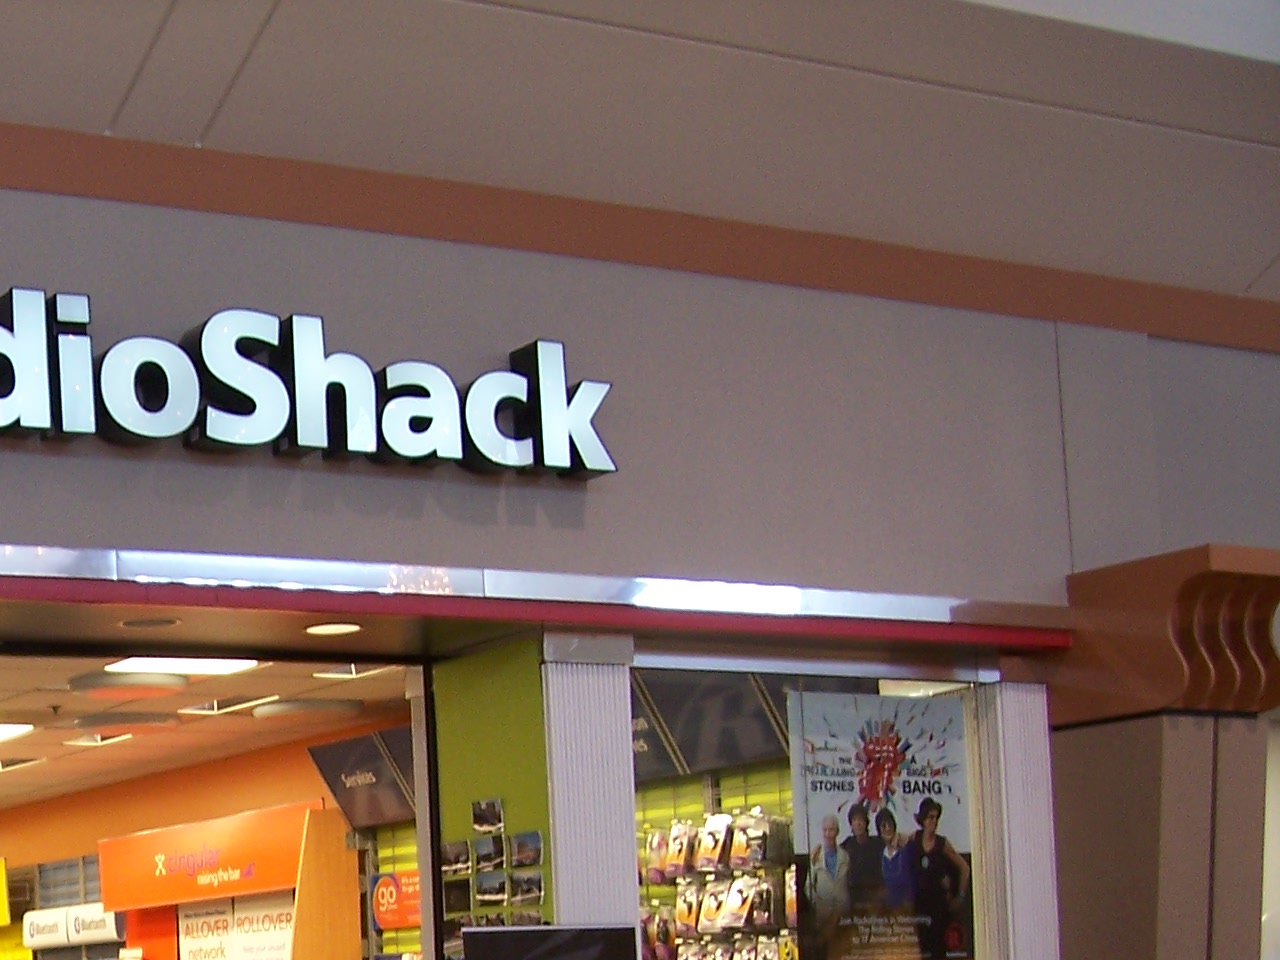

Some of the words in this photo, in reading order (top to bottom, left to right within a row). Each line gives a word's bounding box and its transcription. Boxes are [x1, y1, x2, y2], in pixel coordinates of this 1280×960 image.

[810, 779, 856, 793] STONES
[902, 779, 942, 794] BANG
[378, 884, 397, 912] go
[236, 912, 293, 934] ROLLOVER
[188, 940, 227, 960] network
